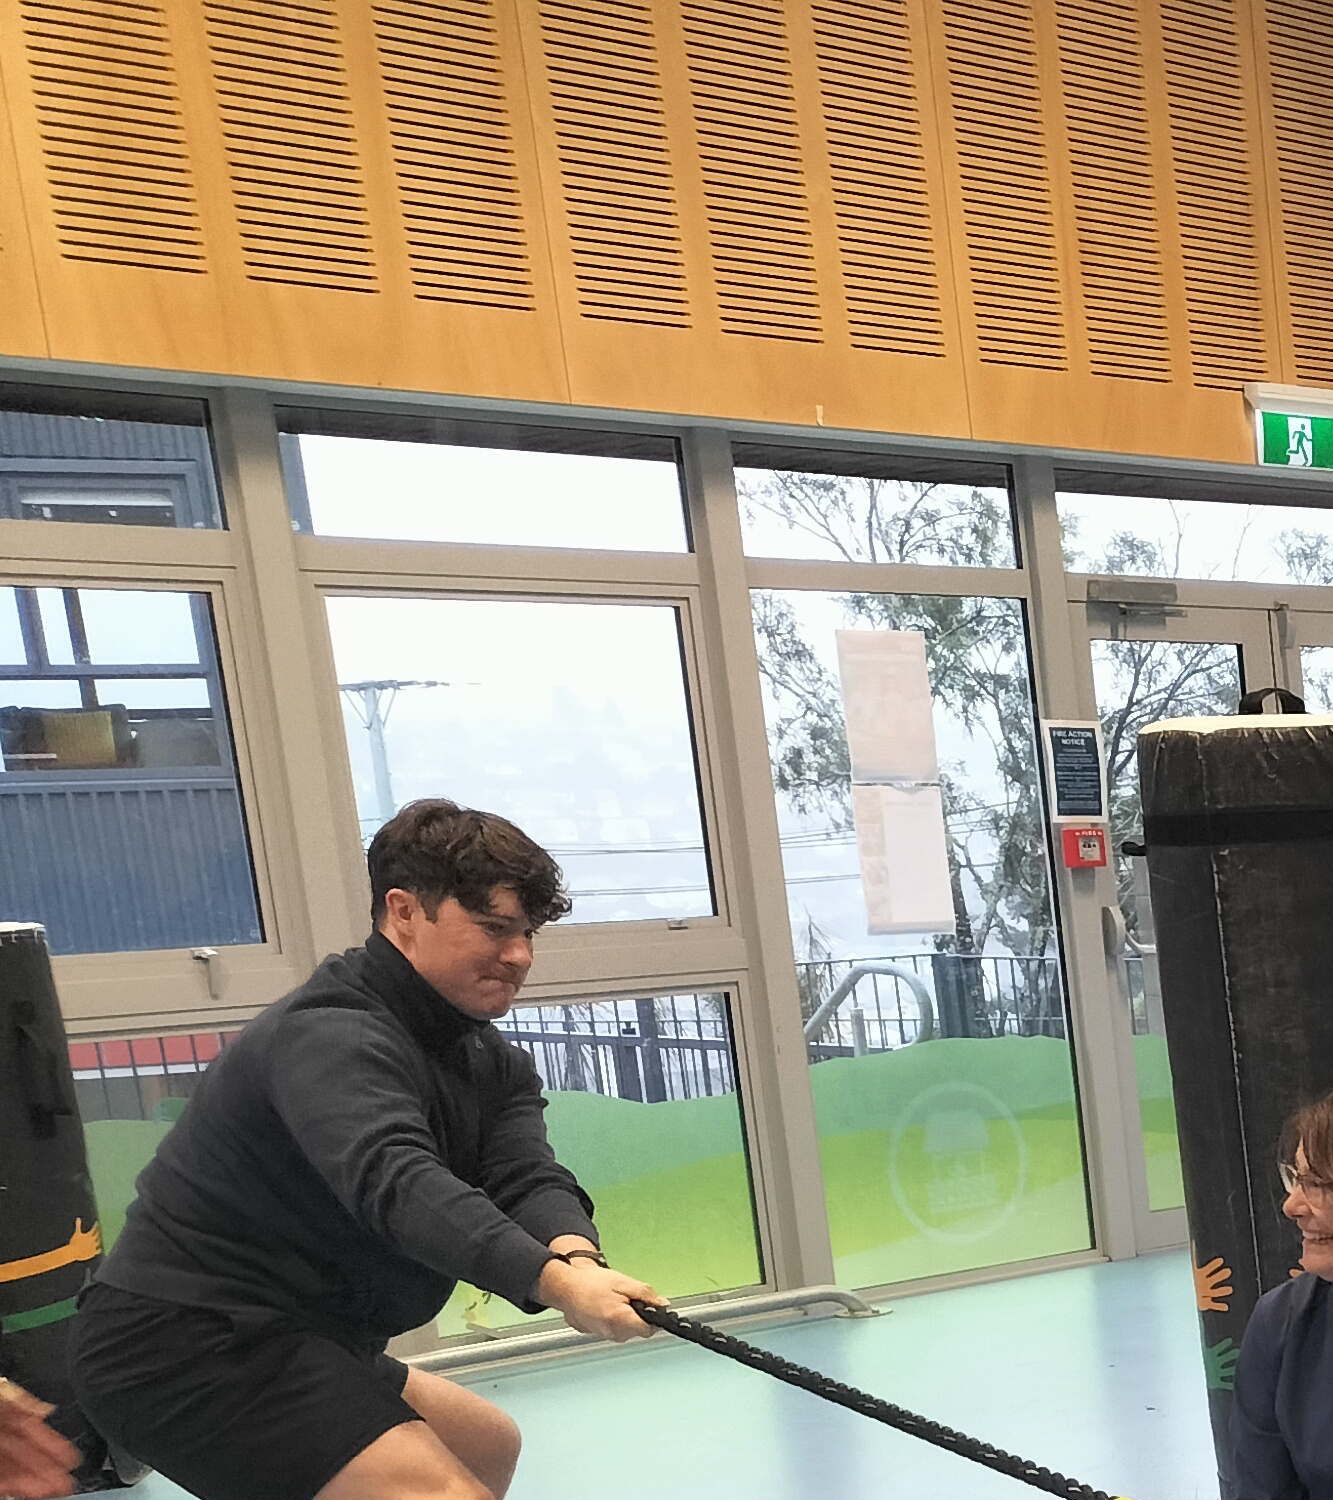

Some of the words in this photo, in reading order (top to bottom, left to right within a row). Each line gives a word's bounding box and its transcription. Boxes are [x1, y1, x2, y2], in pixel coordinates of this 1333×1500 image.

[1052, 730, 1067, 738] FIRE
[1068, 730, 1093, 738] ACTION
[1061, 738, 1086, 746] NOTICE
